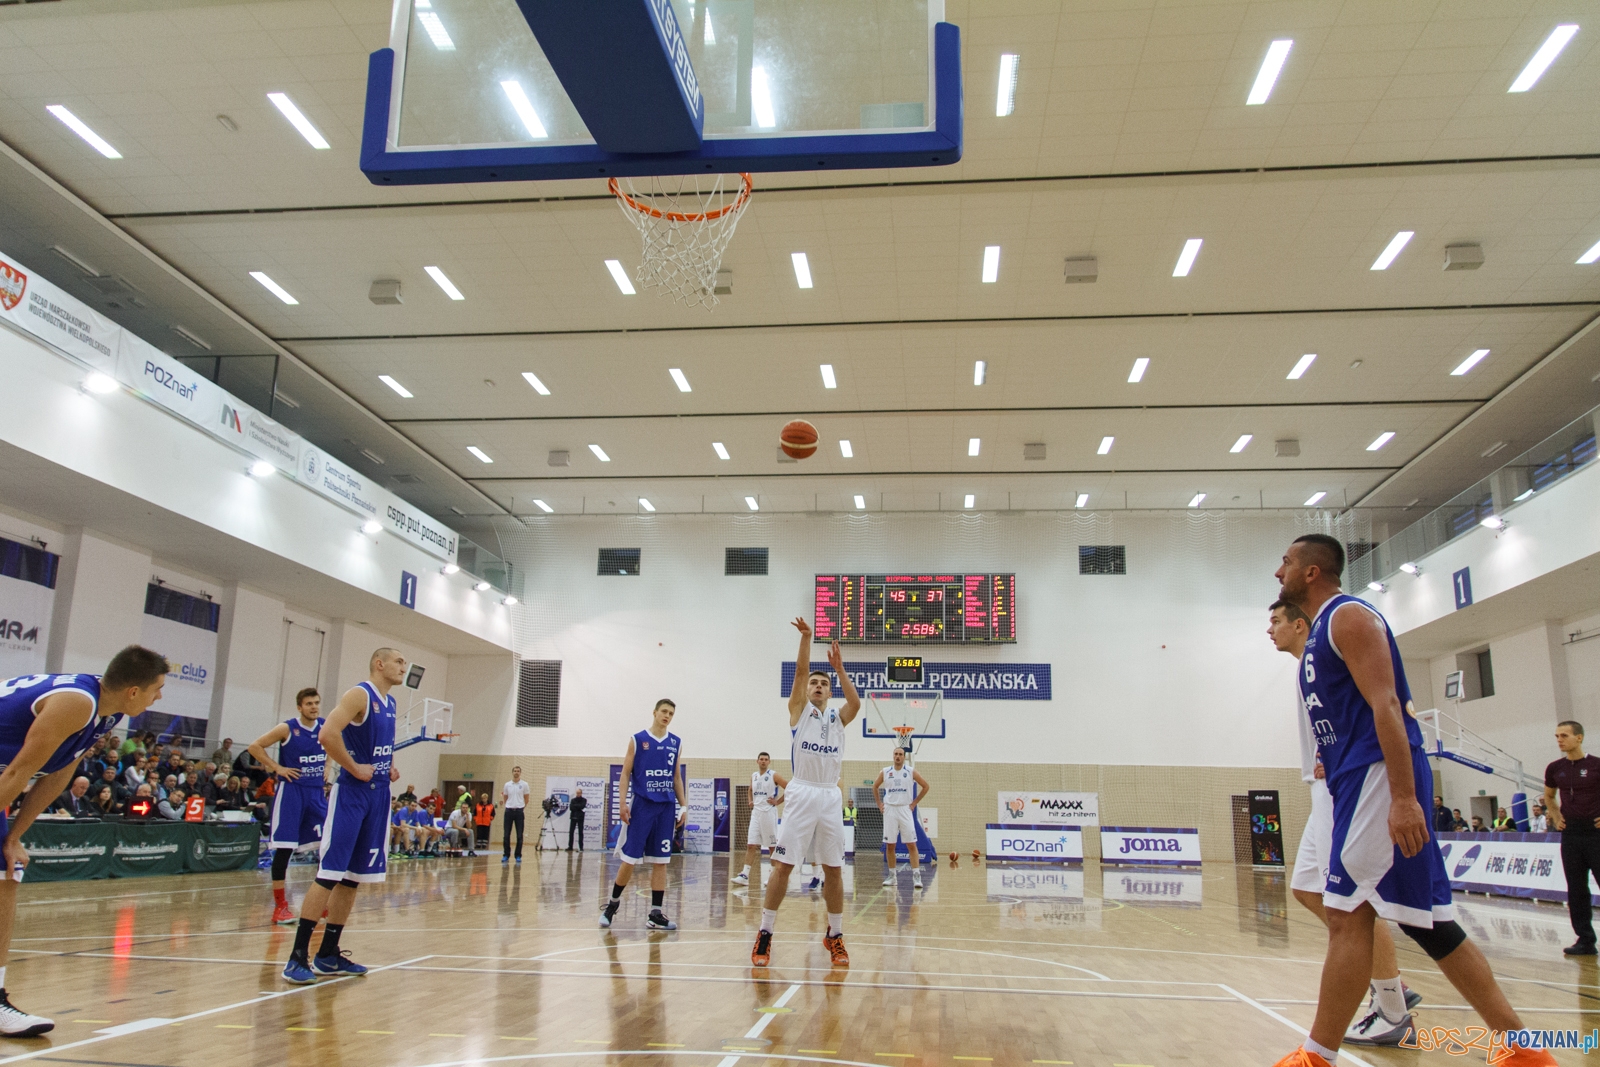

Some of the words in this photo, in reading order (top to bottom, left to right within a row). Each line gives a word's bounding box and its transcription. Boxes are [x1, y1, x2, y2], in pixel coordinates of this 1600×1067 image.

[665, 6, 699, 112] SYSTEM
[30, 291, 48, 310] URZĄD
[49, 300, 90, 333] MARSZAŁKOWSKI
[28, 304, 68, 332] WOJEWÓDZTWA
[67, 324, 110, 357] WIELKOPOLSKIEGO
[325, 461, 346, 482] Centrum
[346, 474, 362, 491] Sportu
[387, 505, 456, 555] cspp.put.poznan.pl
[406, 577, 412, 604] 1
[890, 590, 906, 602] 45
[926, 590, 943, 602] 37
[1457, 573, 1466, 604] 1
[1305, 653, 1316, 683] 6
[928, 670, 1038, 690] POZNAŃSKA
[668, 752, 675, 766] 3
[188, 799, 203, 815] 5
[1040, 800, 1083, 810] MAXXX
[661, 839, 671, 853] 3
[368, 848, 379, 867] 7
[1490, 856, 1506, 873] PBG
[1512, 857, 1528, 875] PBG
[1536, 859, 1553, 877] PBG
